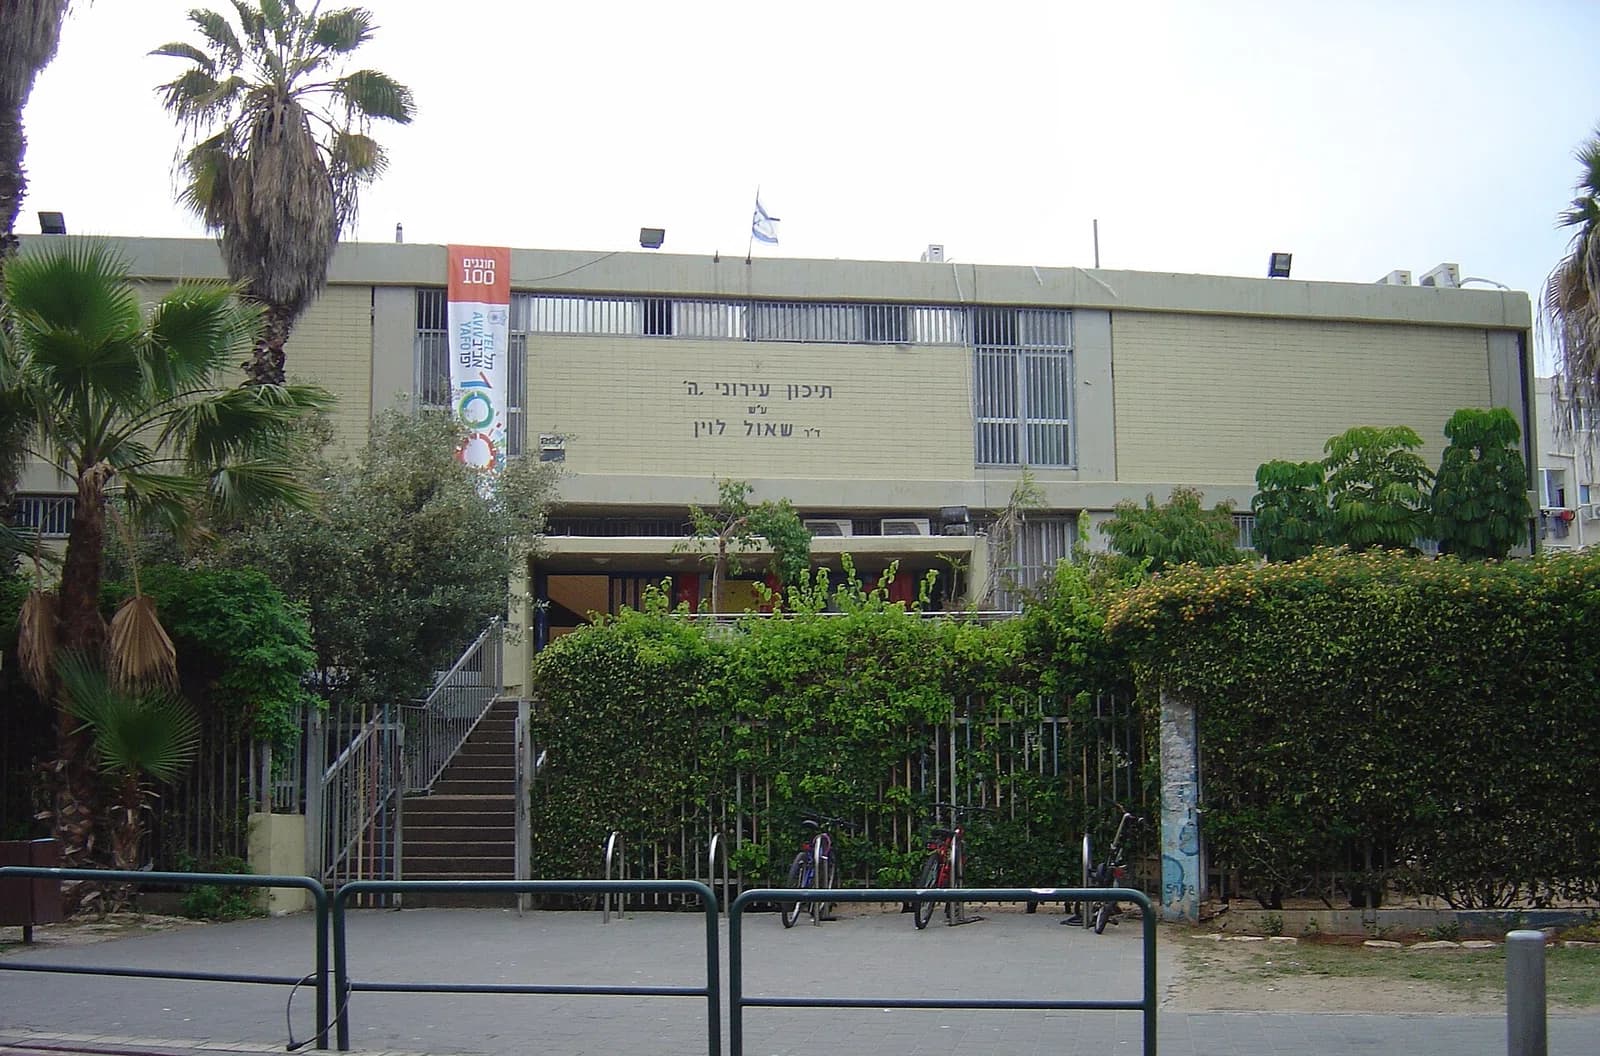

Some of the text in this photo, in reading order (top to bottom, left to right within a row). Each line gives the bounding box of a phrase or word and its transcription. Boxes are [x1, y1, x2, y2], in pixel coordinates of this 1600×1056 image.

[463, 268, 495, 286] 100
[472, 311, 483, 338] AVIV
[459, 321, 471, 351] YAFO
[484, 332, 495, 351] TEL
[459, 351, 471, 368] יפו
[472, 339, 483, 368] אביב
[484, 353, 497, 370] תל
[715, 381, 770, 398] עירוני
[787, 384, 832, 401] תיכון
[694, 419, 726, 438] לוין
[743, 420, 793, 437] שאול
